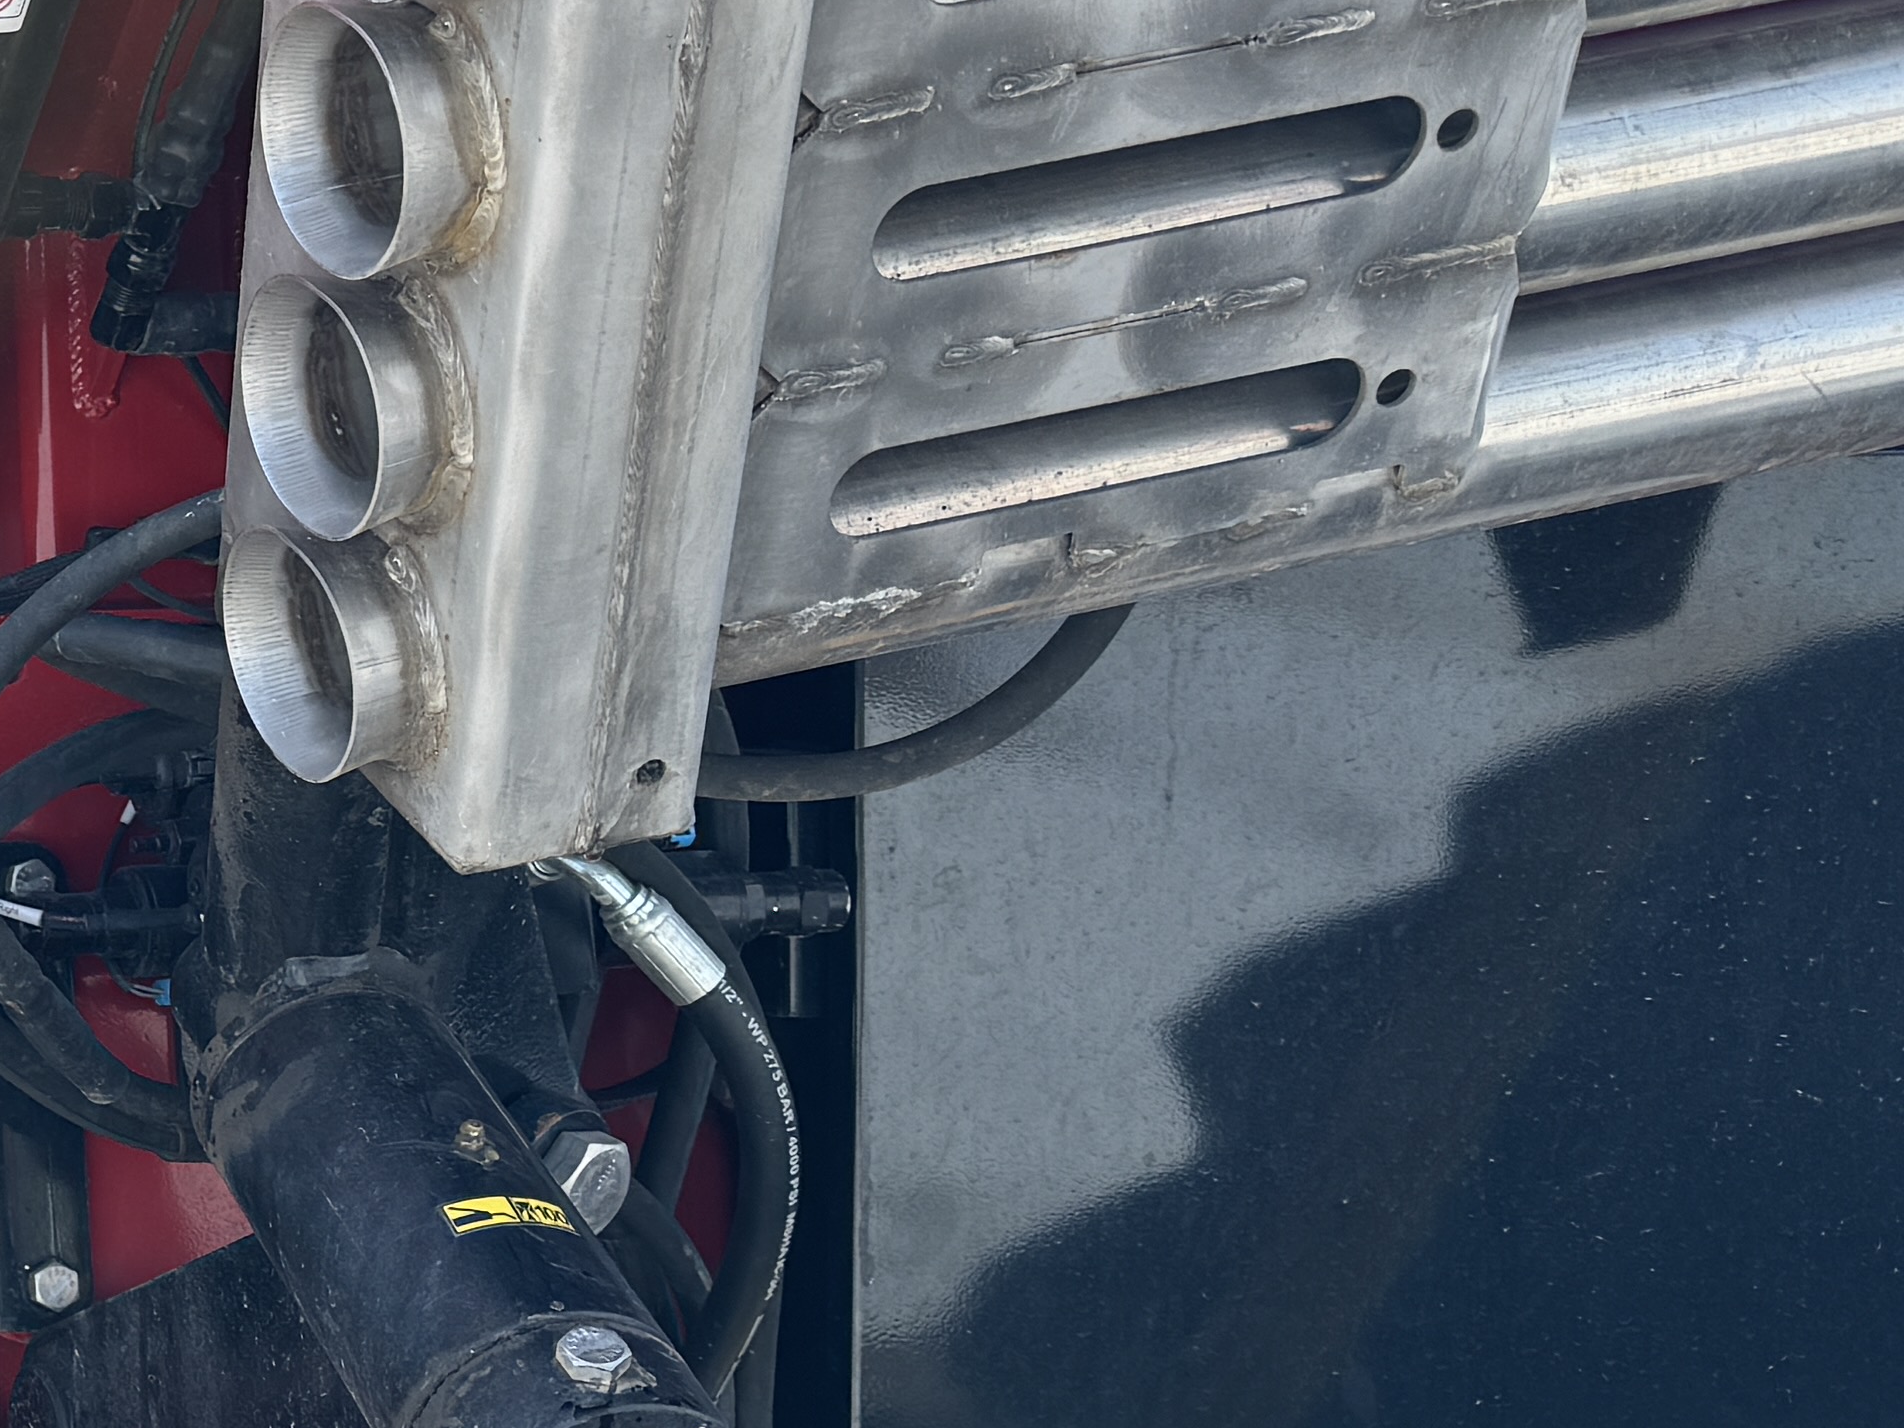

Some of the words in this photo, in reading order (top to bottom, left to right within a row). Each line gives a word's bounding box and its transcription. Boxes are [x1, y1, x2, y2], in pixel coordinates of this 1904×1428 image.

[746, 1016, 769, 1048] WP
[762, 1048, 783, 1083] 275
[775, 1085, 797, 1125] BAR
[788, 1135, 800, 1177] 4000
[535, 1205, 571, 1225] 100
